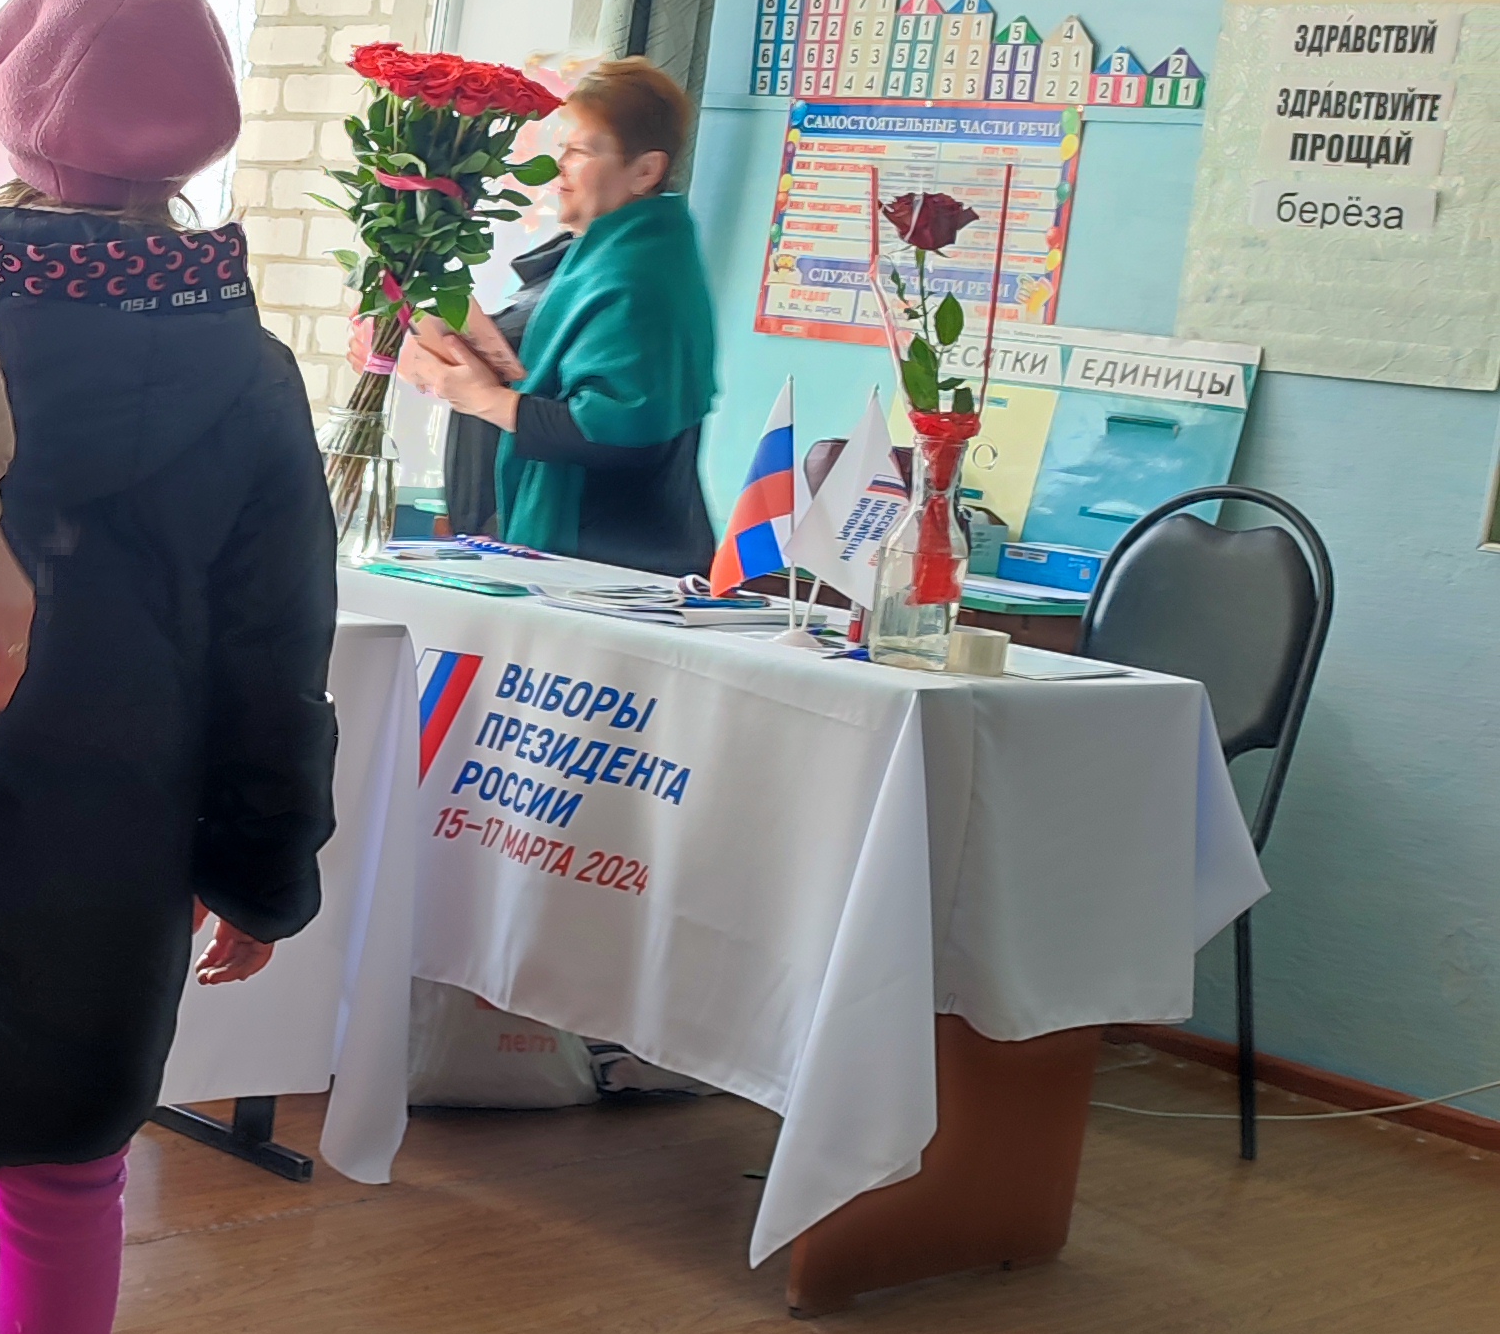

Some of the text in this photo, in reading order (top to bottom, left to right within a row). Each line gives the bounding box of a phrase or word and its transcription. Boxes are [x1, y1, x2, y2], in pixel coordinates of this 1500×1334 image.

[803, 114, 1061, 137] САМОСТОЯТЕЛЬНЫЕ ЧАСТИ РЕЧИ
[1277, 192, 1404, 230] берёза
[1080, 357, 1236, 398] ЕДИНИЦЫ
[495, 663, 658, 733] ВЫБОРЫ
[475, 711, 691, 806] ПРЕЗИДЕНТА
[450, 760, 584, 828] РОССИИ
[500, 824, 576, 878] МАРТА
[574, 851, 649, 896] 2024
